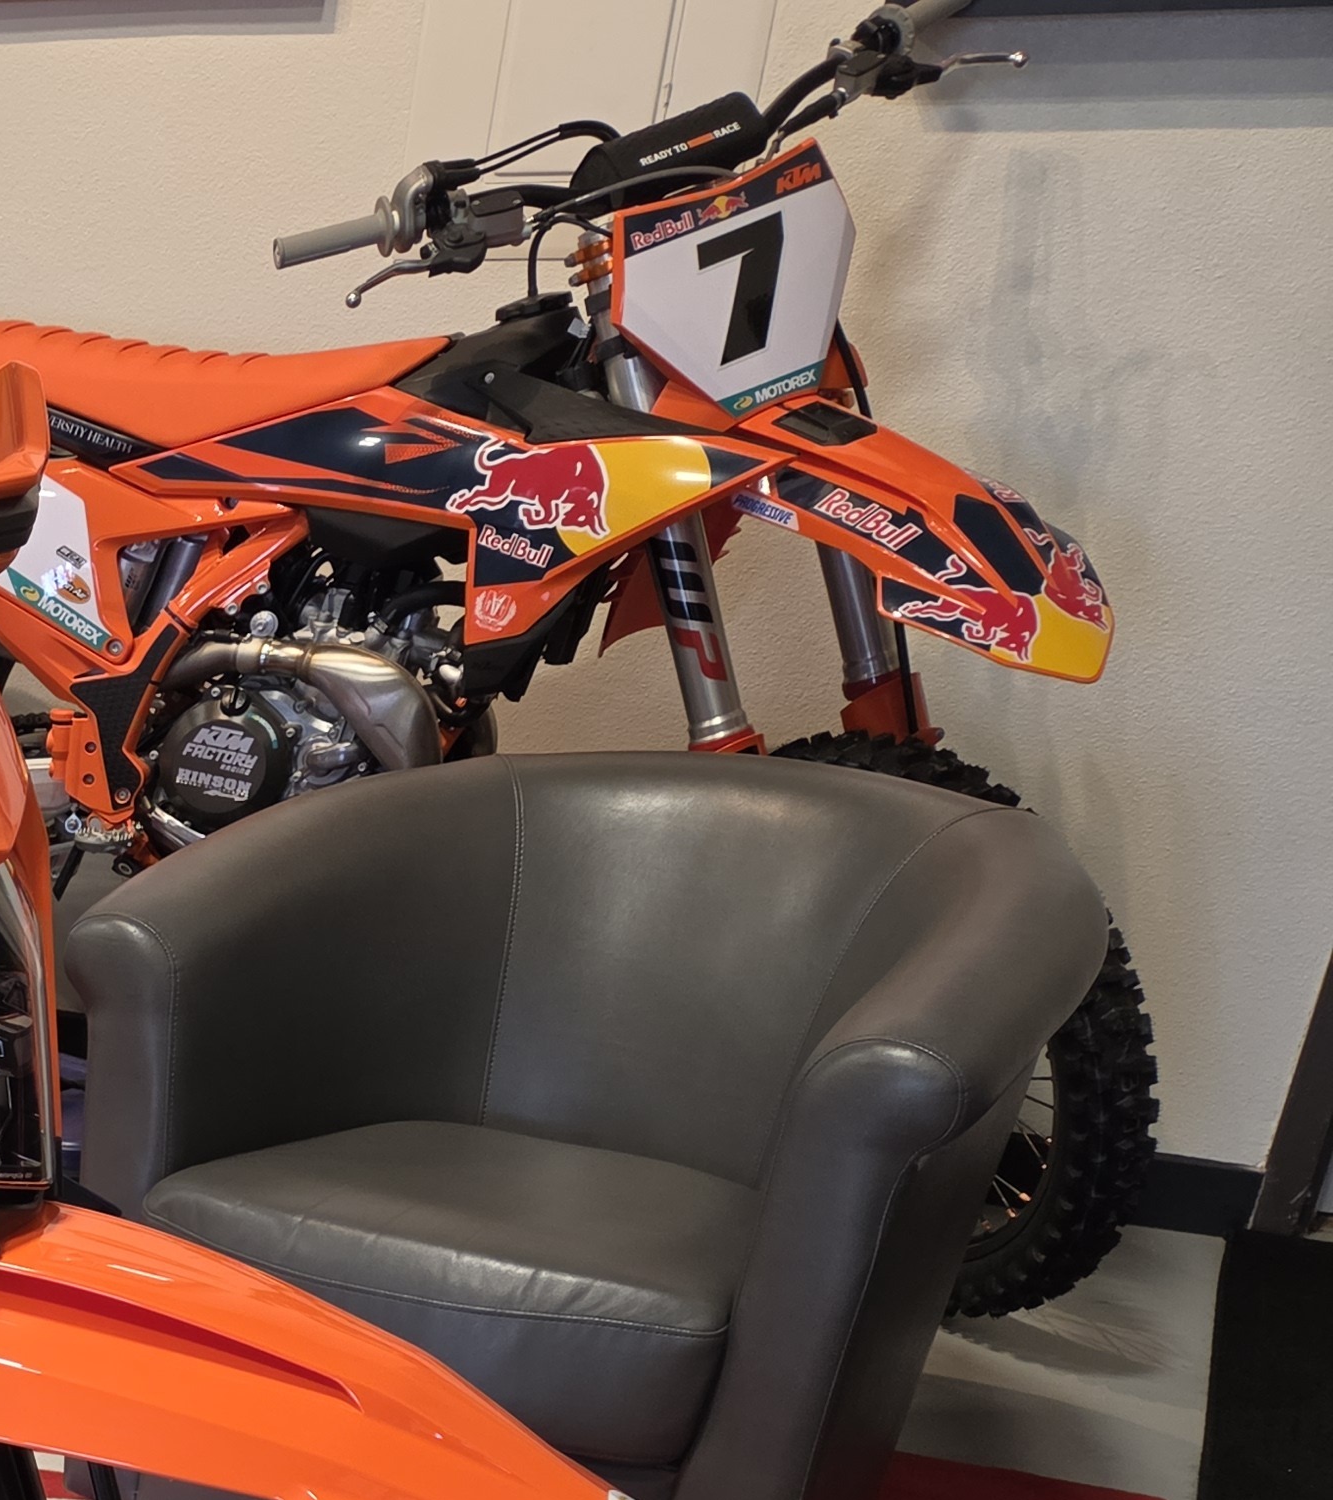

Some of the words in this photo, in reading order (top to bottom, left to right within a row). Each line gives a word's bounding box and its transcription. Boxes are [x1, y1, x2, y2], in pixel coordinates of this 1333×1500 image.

[639, 149, 674, 167] READY
[675, 143, 689, 154] TO
[713, 121, 742, 139] RACE
[775, 161, 822, 195] KTM
[696, 210, 784, 366] 7
[754, 368, 816, 404] MOTOREX
[86, 430, 134, 455] HEALTH
[733, 492, 794, 526] PROGRESSIVE
[37, 596, 103, 646] MOTOREX
[182, 742, 258, 769] FACTORY
[193, 725, 255, 753] KTM
[177, 767, 252, 793] HINSON
[220, 763, 251, 776] RACING
